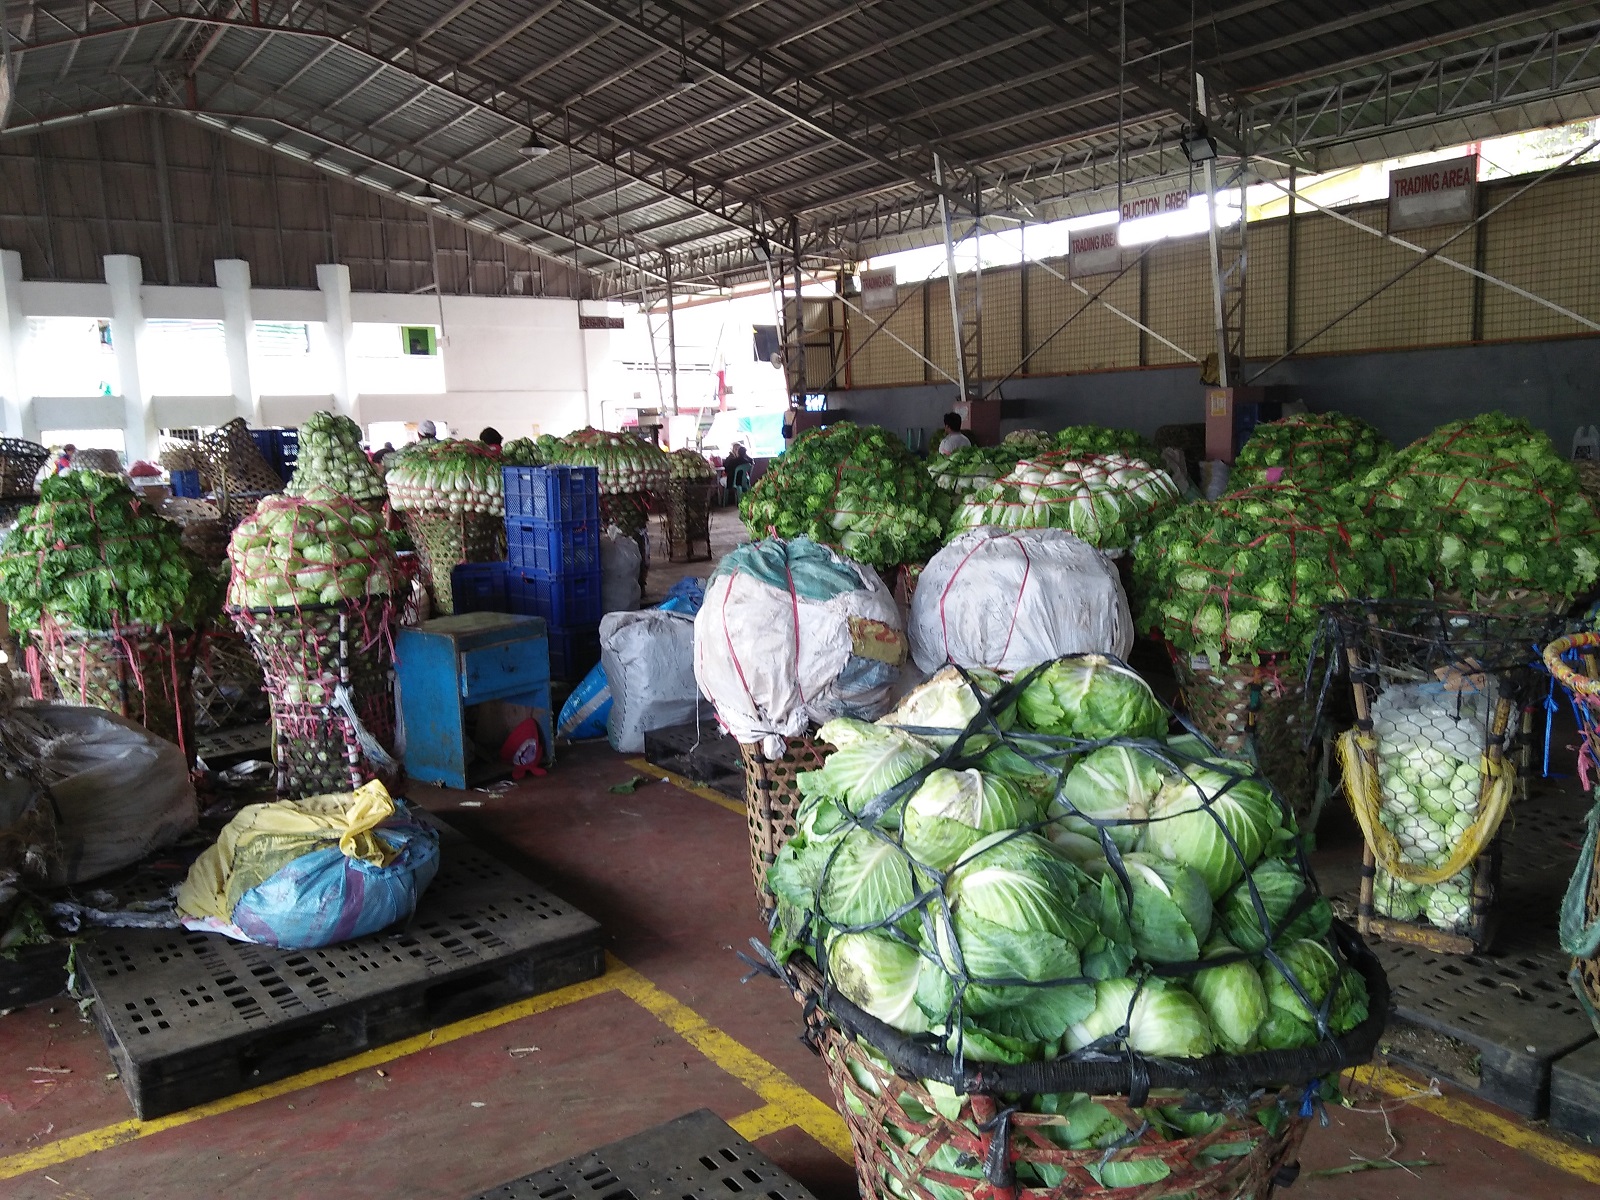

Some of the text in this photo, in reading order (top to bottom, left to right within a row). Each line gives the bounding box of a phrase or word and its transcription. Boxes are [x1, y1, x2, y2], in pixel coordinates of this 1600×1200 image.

[1394, 167, 1471, 198] TRADING AREA
[1122, 190, 1188, 221] AUCTION AREA
[1072, 235, 1100, 254] TRADING
